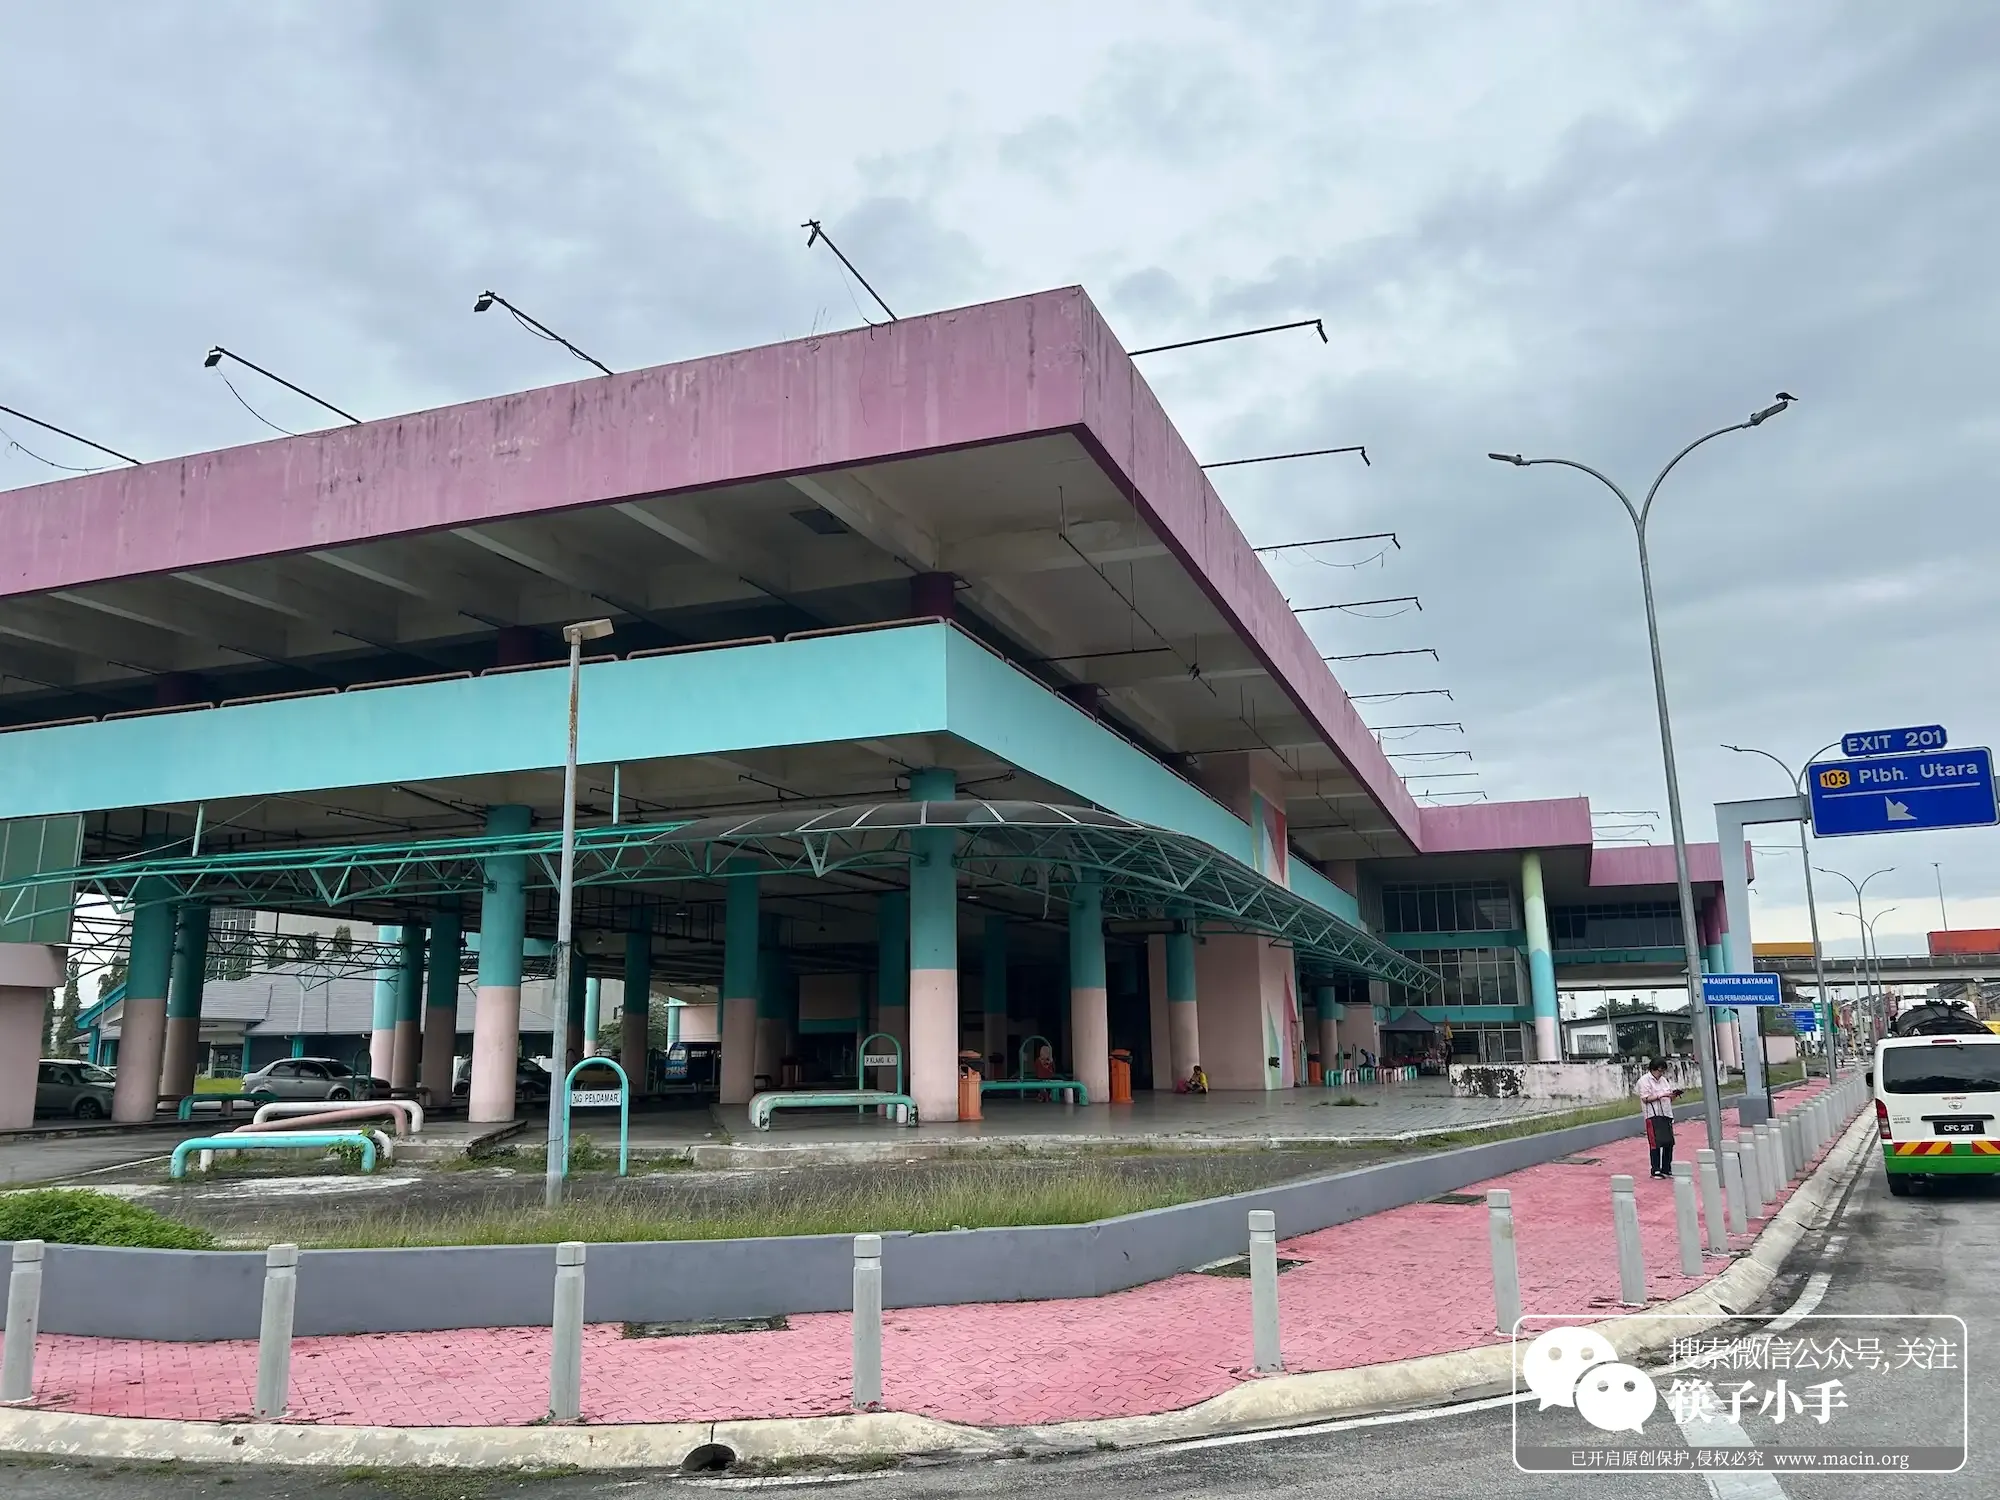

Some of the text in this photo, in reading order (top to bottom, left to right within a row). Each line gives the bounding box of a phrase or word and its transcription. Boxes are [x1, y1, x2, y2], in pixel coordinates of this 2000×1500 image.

[1847, 729, 1942, 752] EXIT 201
[1822, 762, 1979, 786] 103 Plbh. Utara
[1709, 977, 1774, 985] KAUNTER BAYARAN
[1724, 994, 1758, 1002] PERBANDARAN
[1943, 1124, 1960, 1132] CFC
